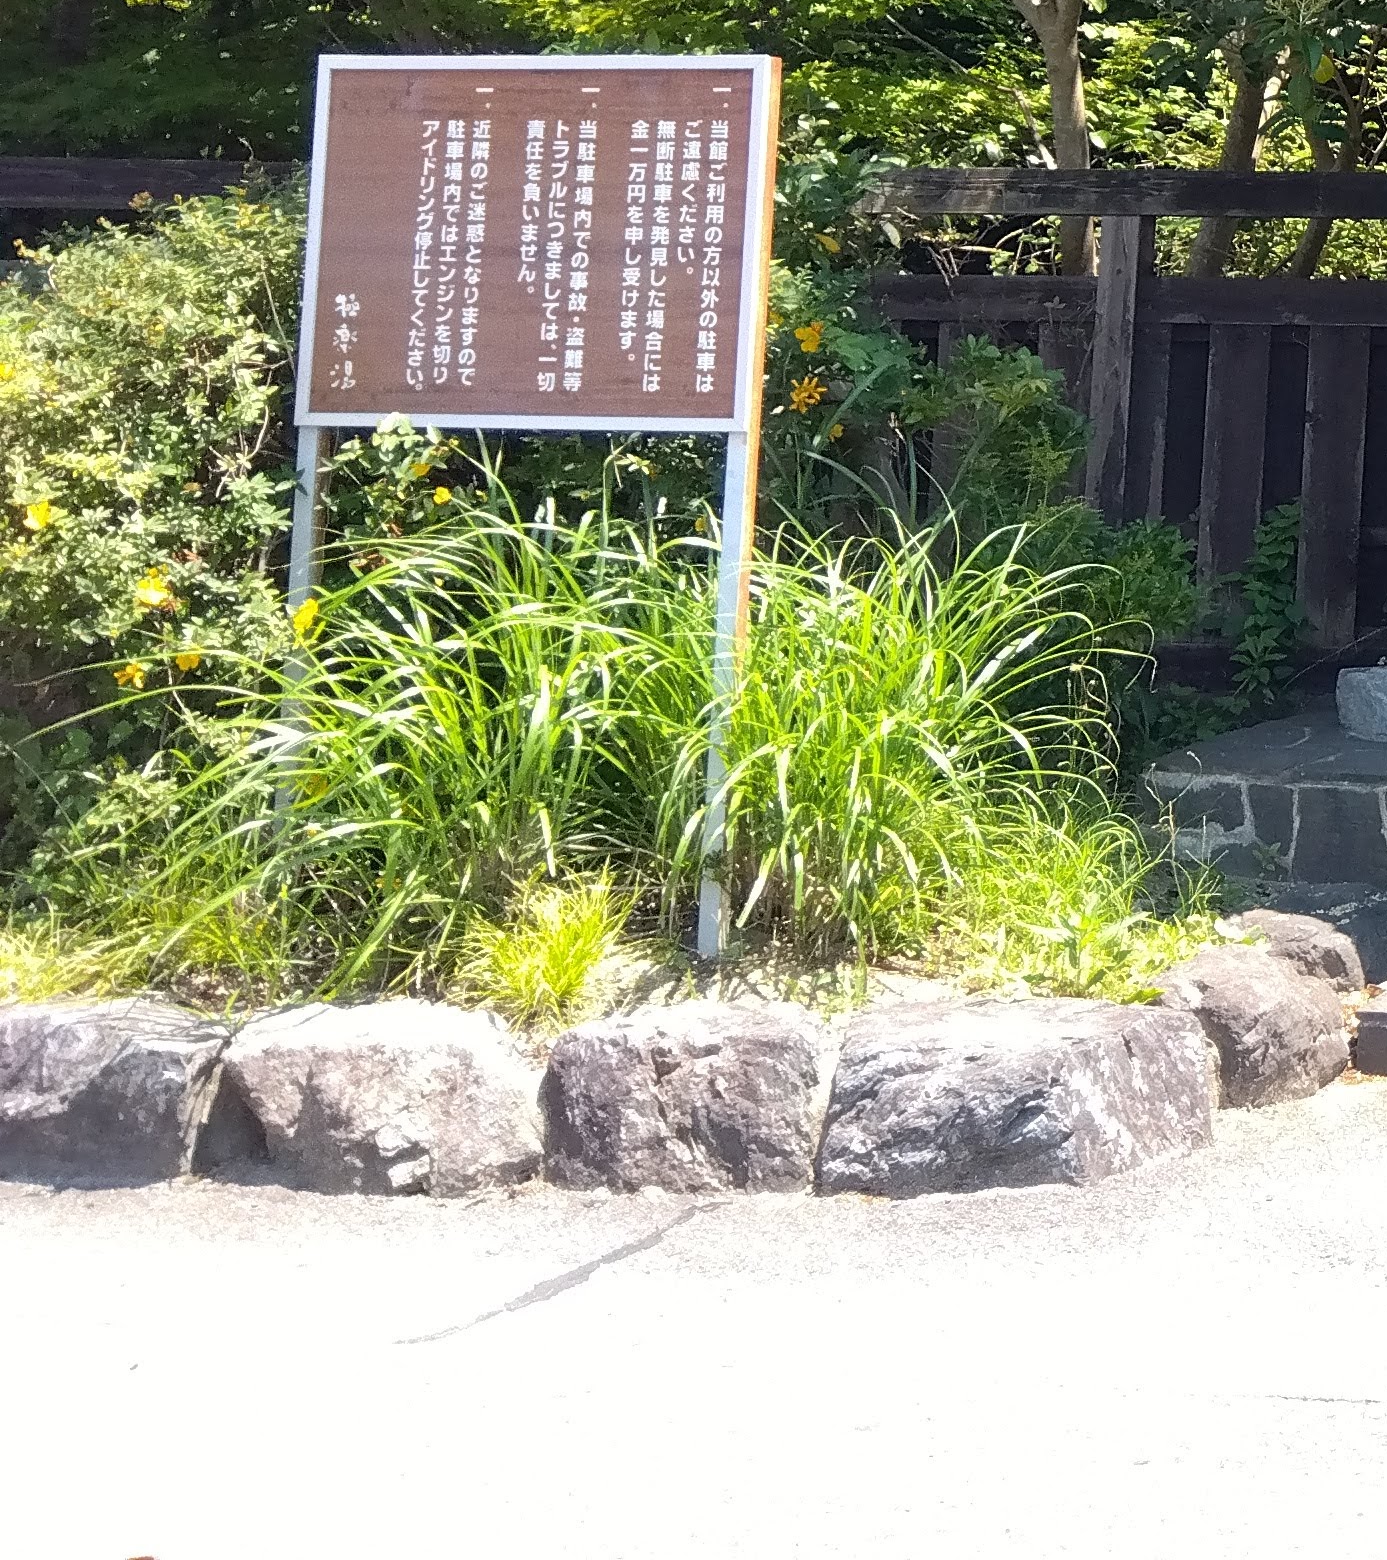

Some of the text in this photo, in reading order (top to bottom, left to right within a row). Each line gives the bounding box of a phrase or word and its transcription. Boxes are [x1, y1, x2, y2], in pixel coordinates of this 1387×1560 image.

[406, 120, 440, 390] アイドリング停止してください。
[432, 120, 466, 385] 駐車場内ではエンジンを切り
[517, 120, 545, 293] 責任を負いません。
[537, 120, 570, 392] トラブルにつきましては、一切
[618, 120, 650, 361] 金一万円を申し受けます。
[643, 120, 676, 392] 無断駐車を発見した場合には
[677, 119, 703, 275] ご遠慮ください。
[330, 293, 360, 390] 極楽湯
